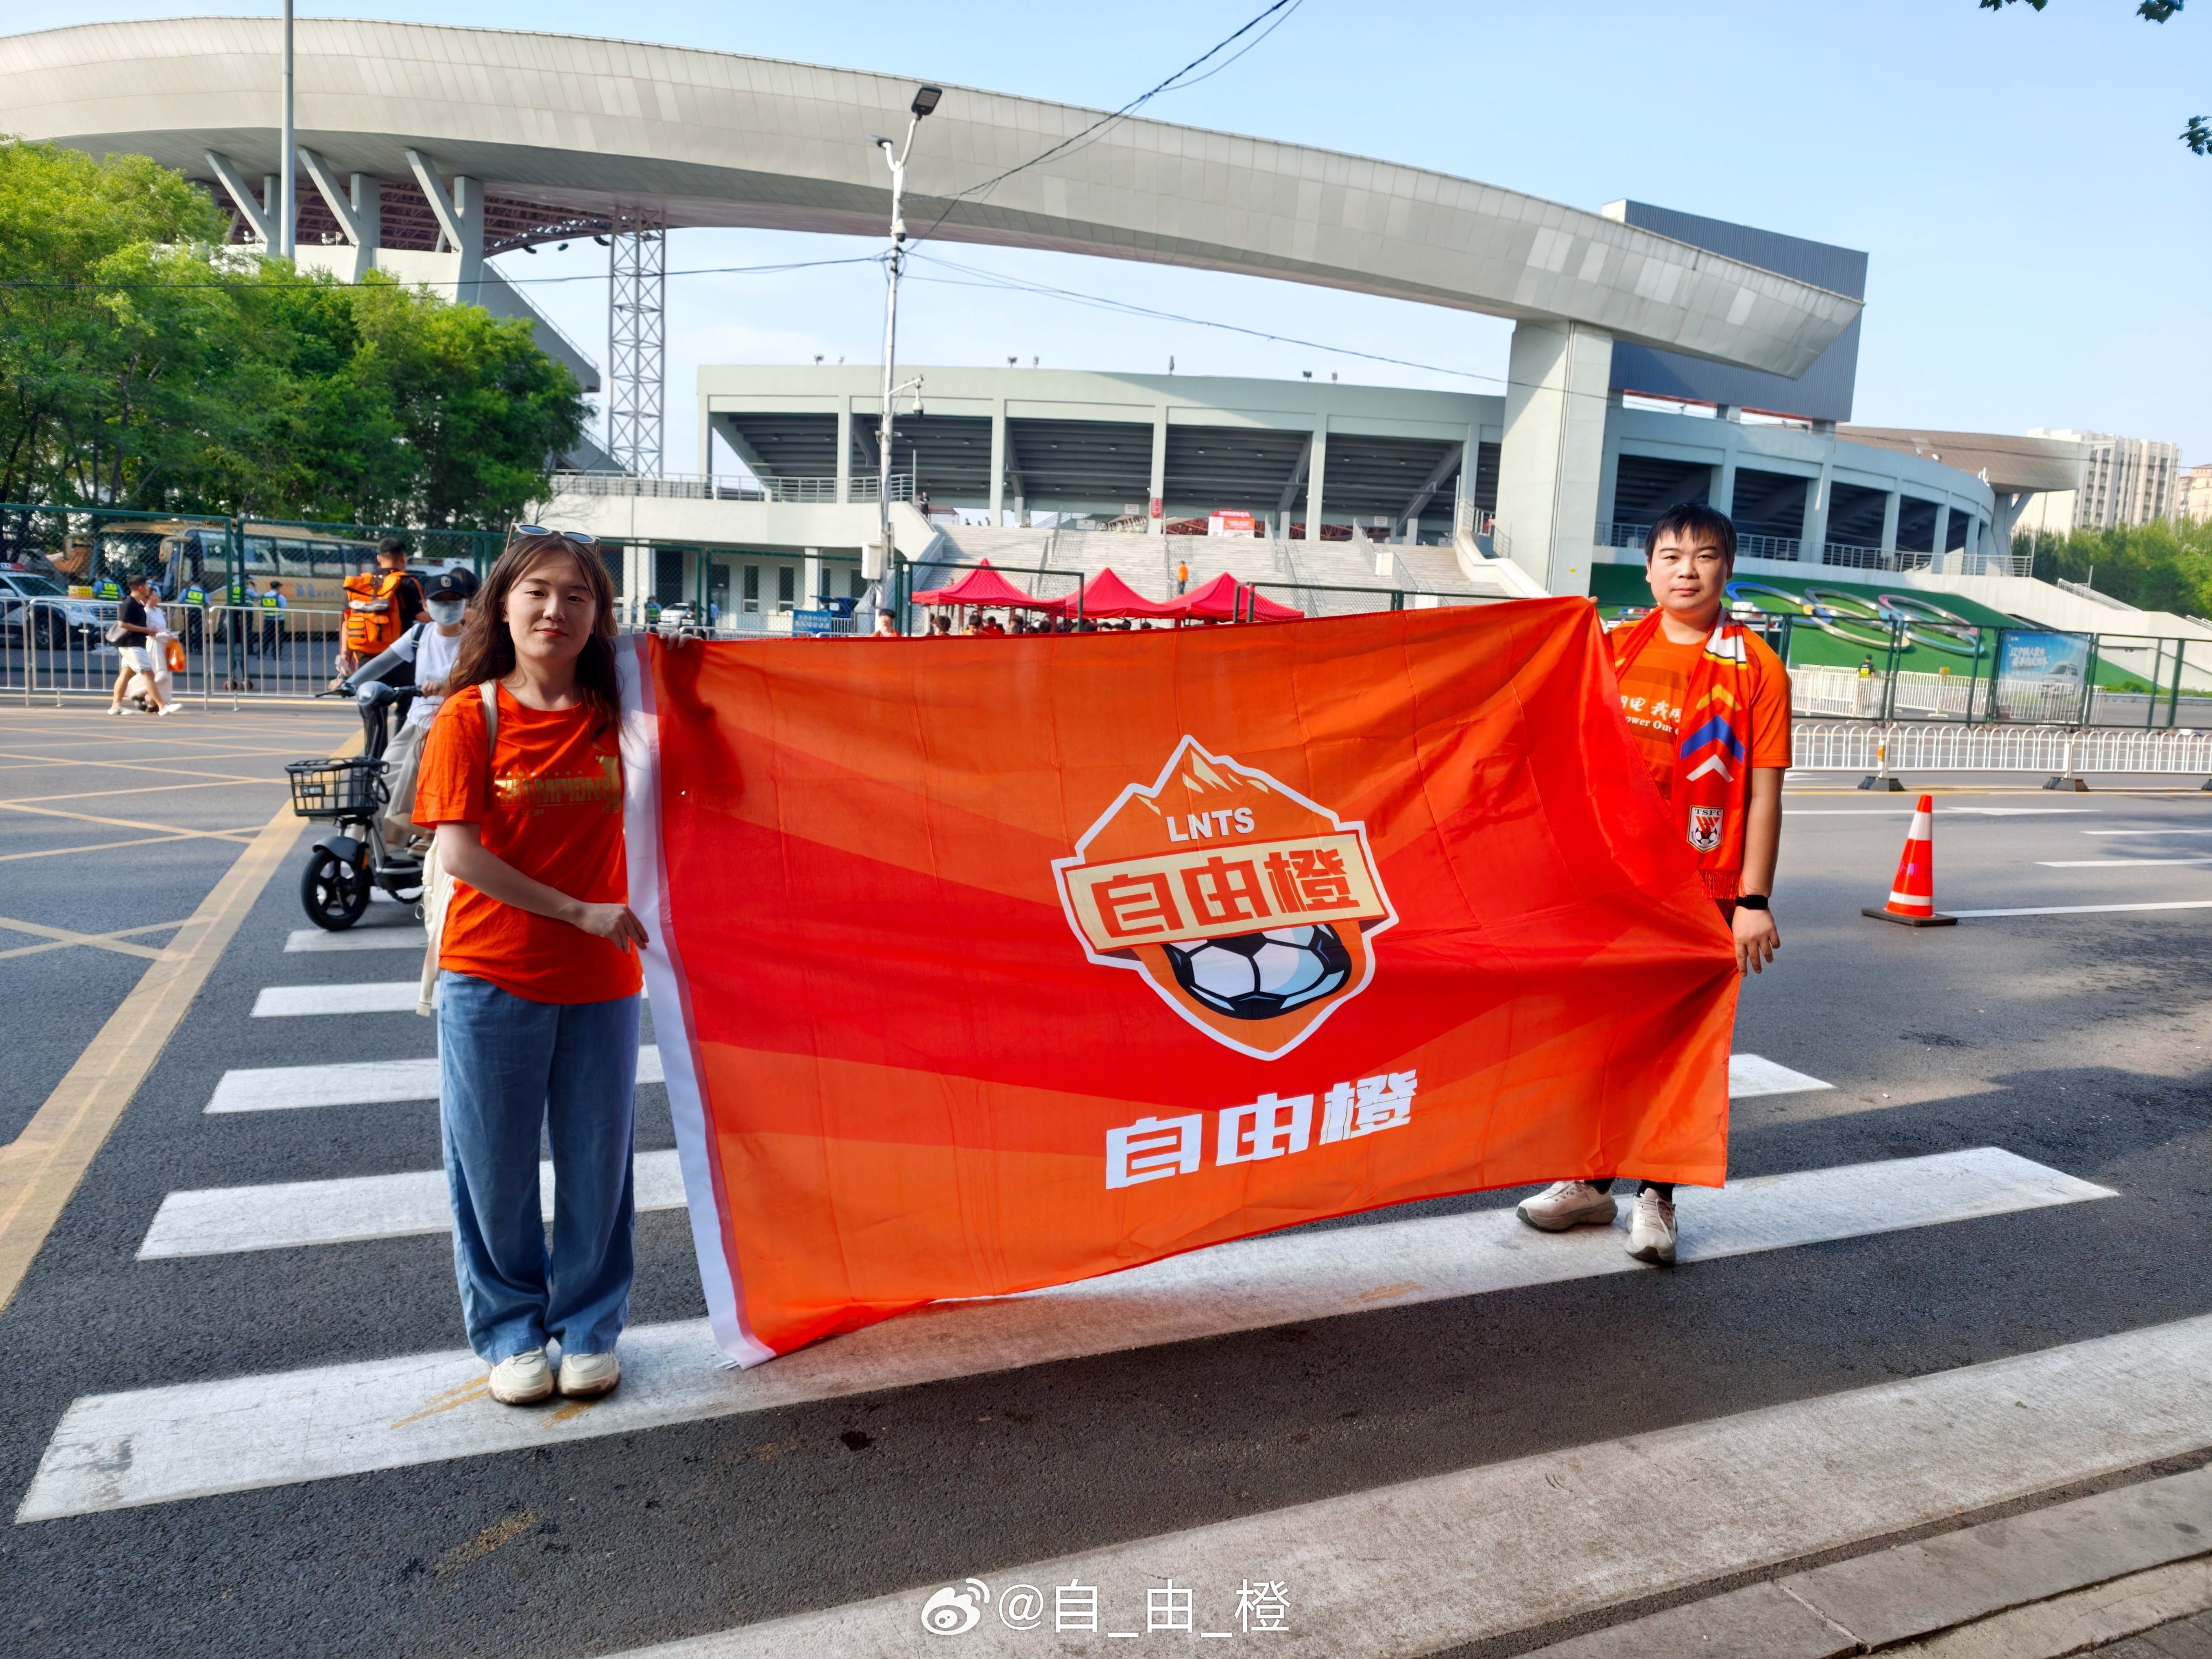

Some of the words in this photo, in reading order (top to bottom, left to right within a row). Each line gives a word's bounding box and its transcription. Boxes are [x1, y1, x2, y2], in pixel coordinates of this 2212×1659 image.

[1625, 716, 1651, 727] ower
[1653, 720, 1673, 733] Our
[1166, 807, 1255, 842] LNTS
[1090, 848, 1361, 939] 自由橙
[1106, 1069, 1417, 1190] 自由橙
